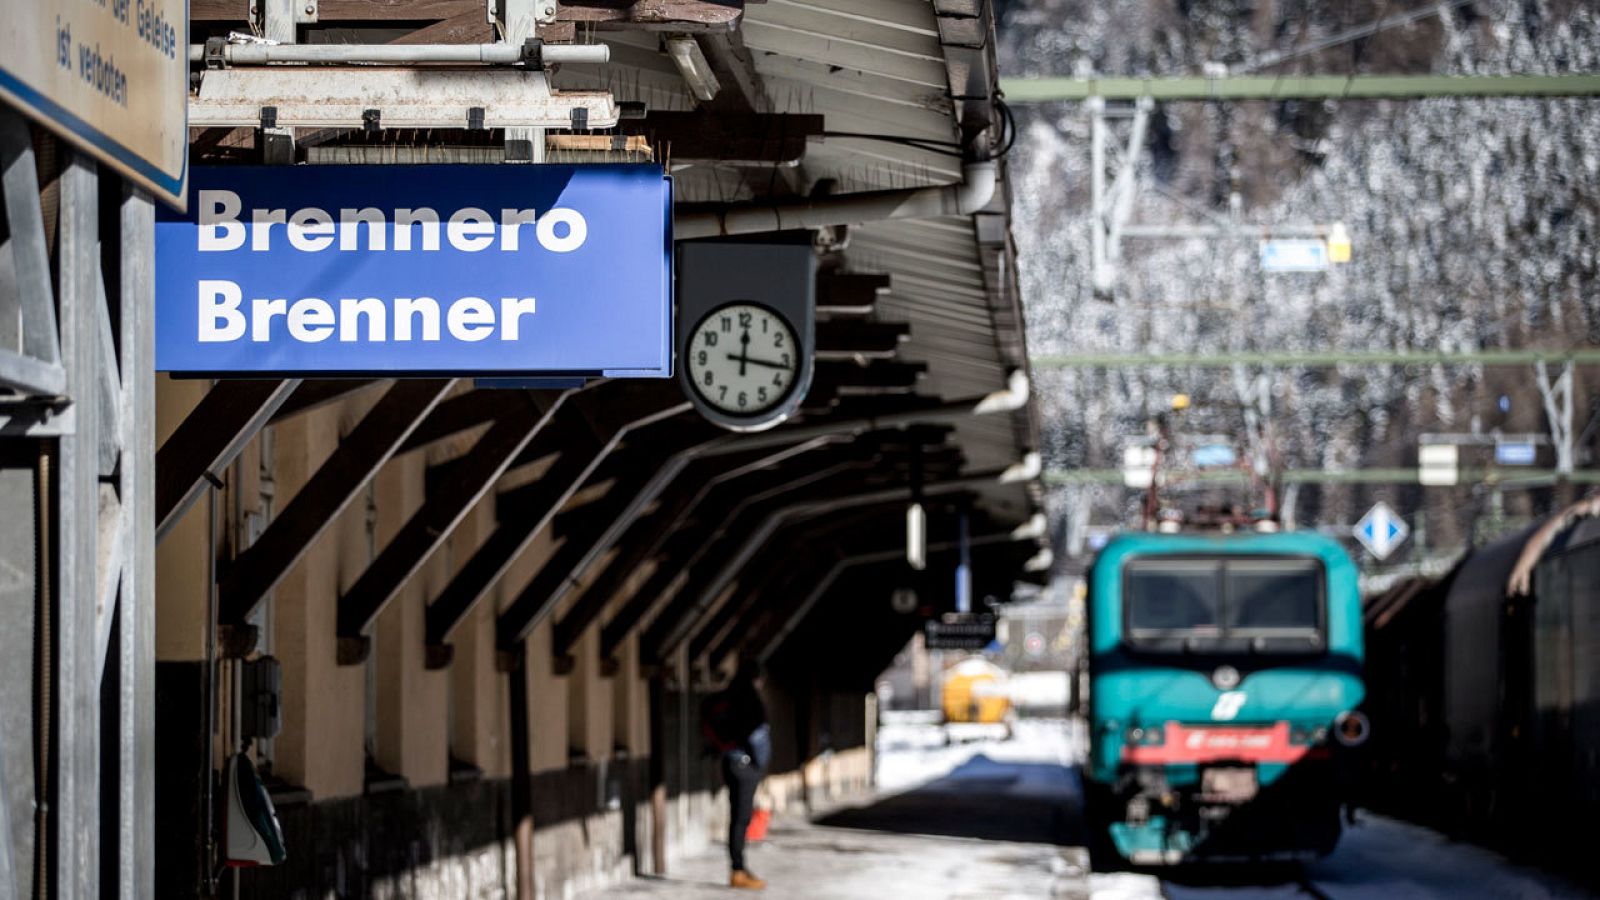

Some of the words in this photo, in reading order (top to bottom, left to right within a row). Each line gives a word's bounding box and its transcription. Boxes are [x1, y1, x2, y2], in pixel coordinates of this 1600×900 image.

[136, 0, 176, 60] Geleise
[56, 14, 71, 70] ist
[79, 42, 128, 109] verboten
[198, 189, 588, 252] Brennero
[198, 279, 536, 342] Brenner
[722, 318, 731, 332] 11
[739, 313, 752, 329] 12
[705, 331, 718, 347] 10
[775, 333, 784, 347] 2
[698, 351, 708, 366] 9
[705, 371, 713, 386] 8
[773, 373, 782, 386] 4
[719, 386, 728, 401] 7
[738, 393, 747, 407] 6
[758, 387, 767, 402] 5
